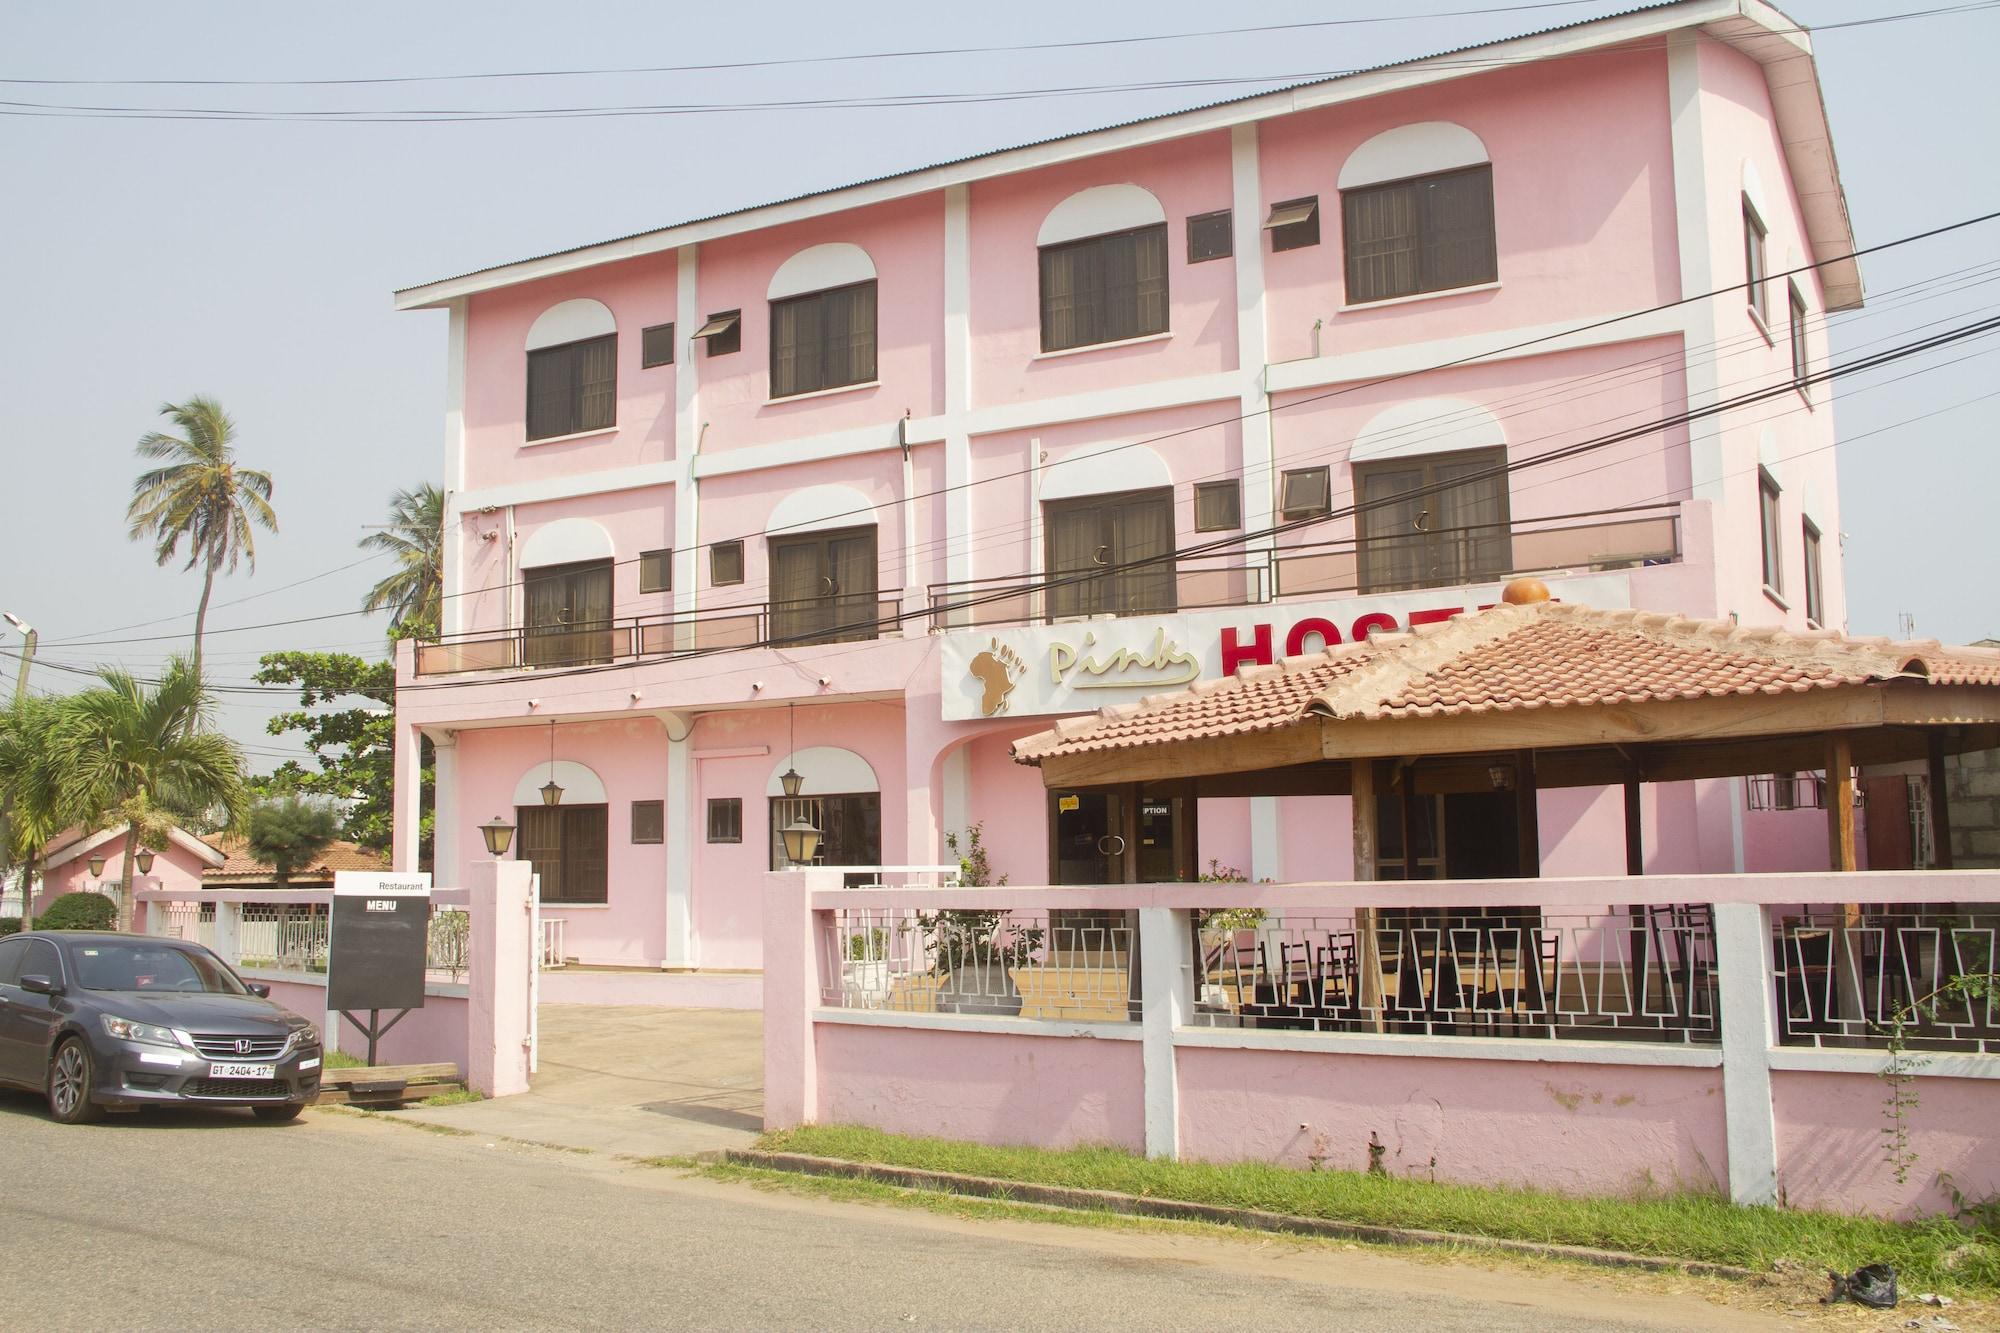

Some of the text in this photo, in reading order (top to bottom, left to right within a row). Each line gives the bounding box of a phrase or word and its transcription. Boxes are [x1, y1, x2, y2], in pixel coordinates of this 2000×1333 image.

[1050, 627, 1200, 689] Pink
[379, 882, 423, 890] Restaurant
[366, 900, 397, 911] MENU
[212, 1065, 225, 1075] GT
